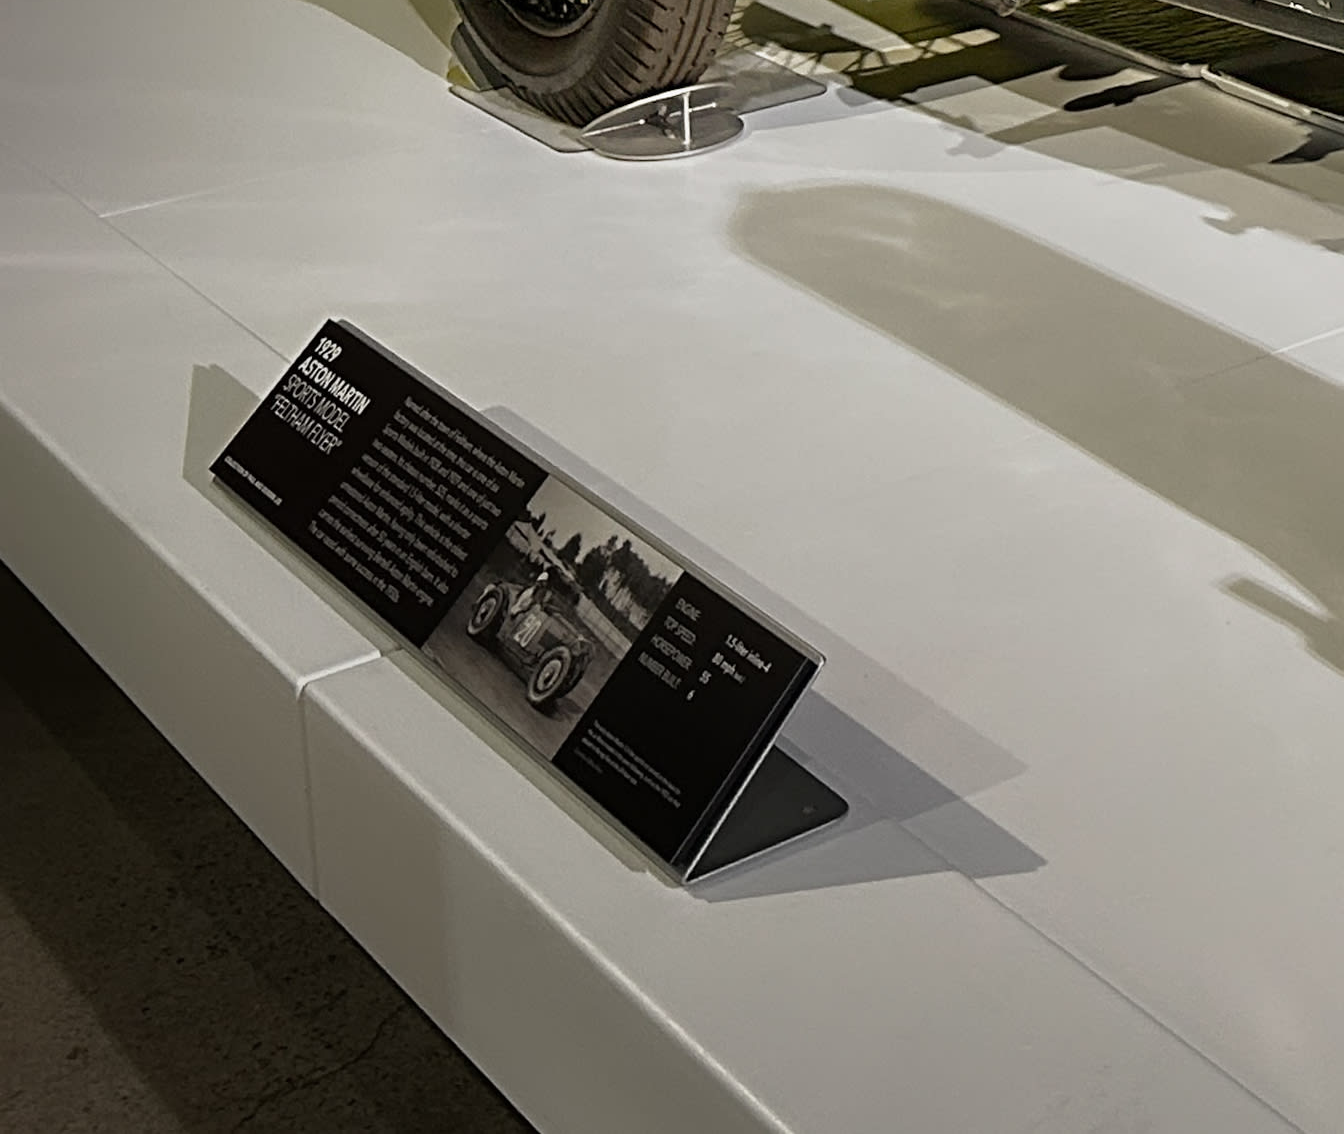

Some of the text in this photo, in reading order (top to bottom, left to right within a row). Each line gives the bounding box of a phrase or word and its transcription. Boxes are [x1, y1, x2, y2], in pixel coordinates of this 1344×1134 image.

[314, 337, 342, 362] 1929
[283, 374, 350, 433] SPORTS MODEL
[298, 356, 371, 415] ASTON MARTIN
